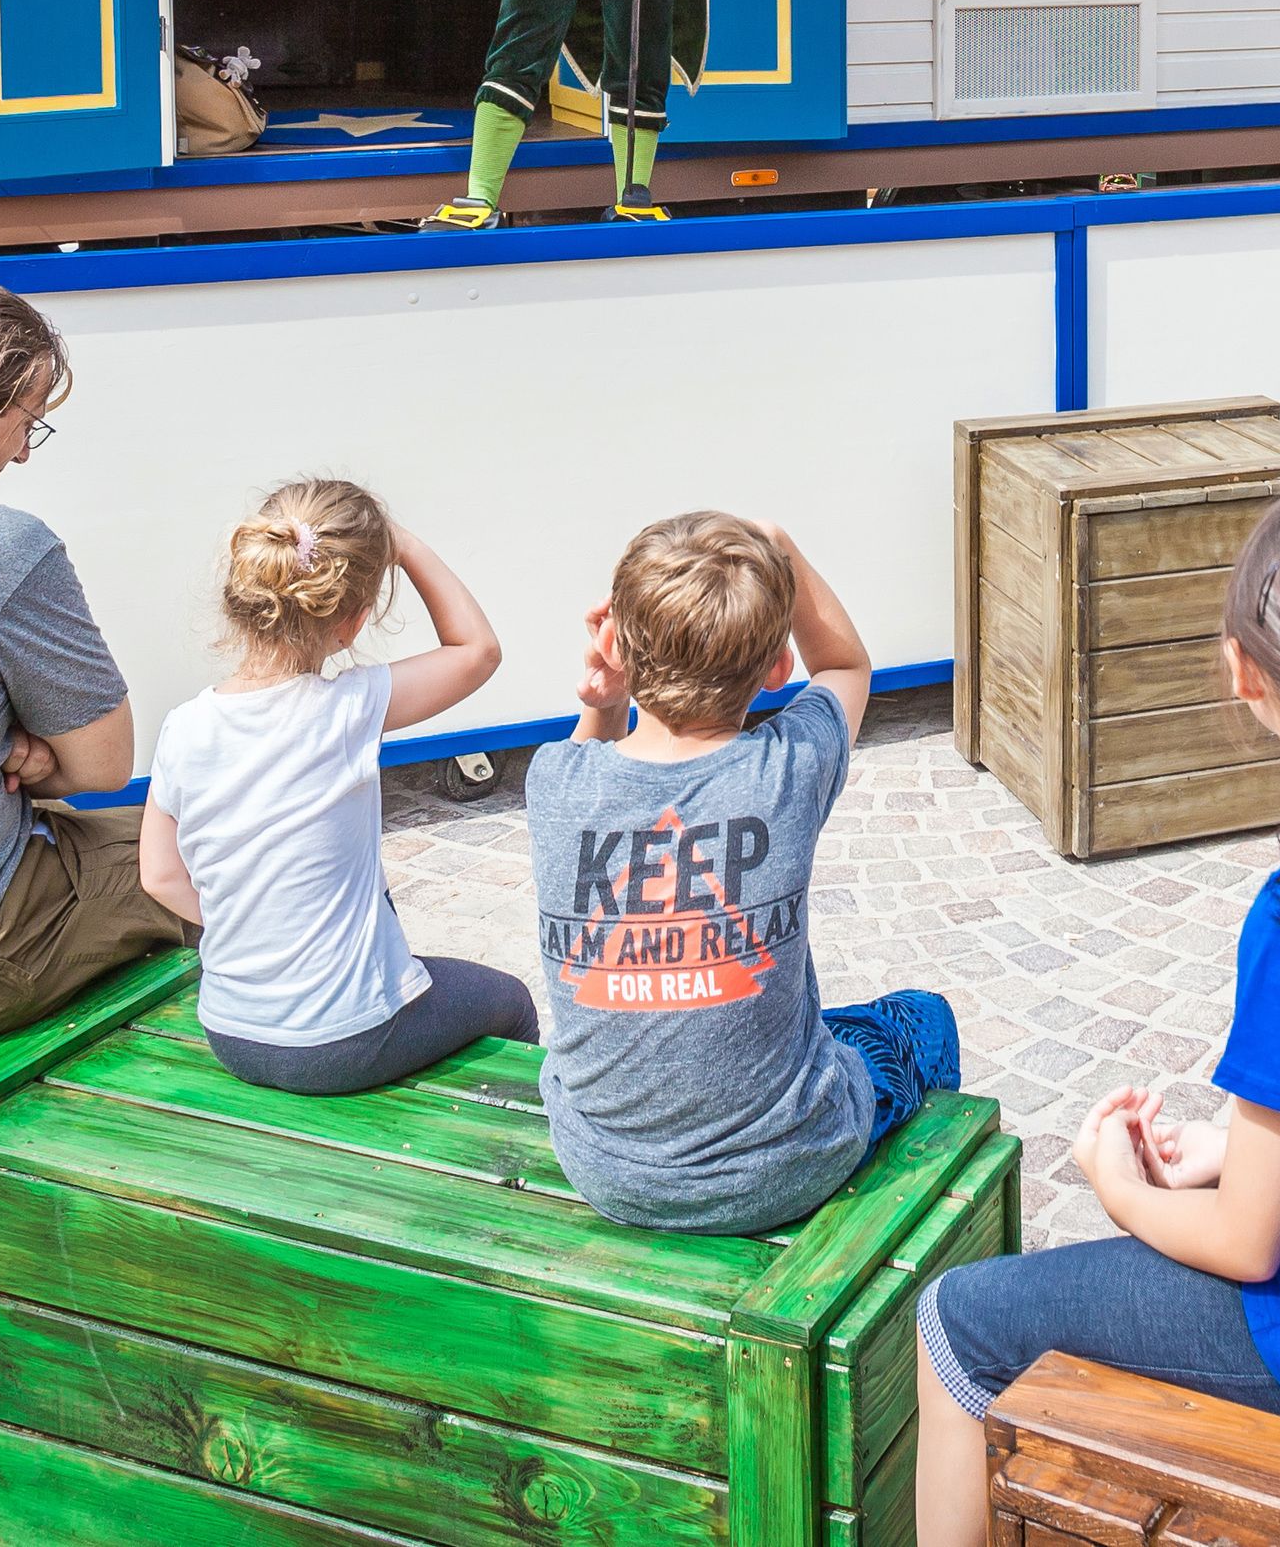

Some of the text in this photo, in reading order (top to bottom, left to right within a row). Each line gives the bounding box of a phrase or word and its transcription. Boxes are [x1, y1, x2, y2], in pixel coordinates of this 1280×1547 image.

[573, 816, 770, 916] KEEP
[617, 927, 685, 966] AND
[699, 895, 803, 962] RELAX
[607, 970, 723, 1002] FOR REAL
